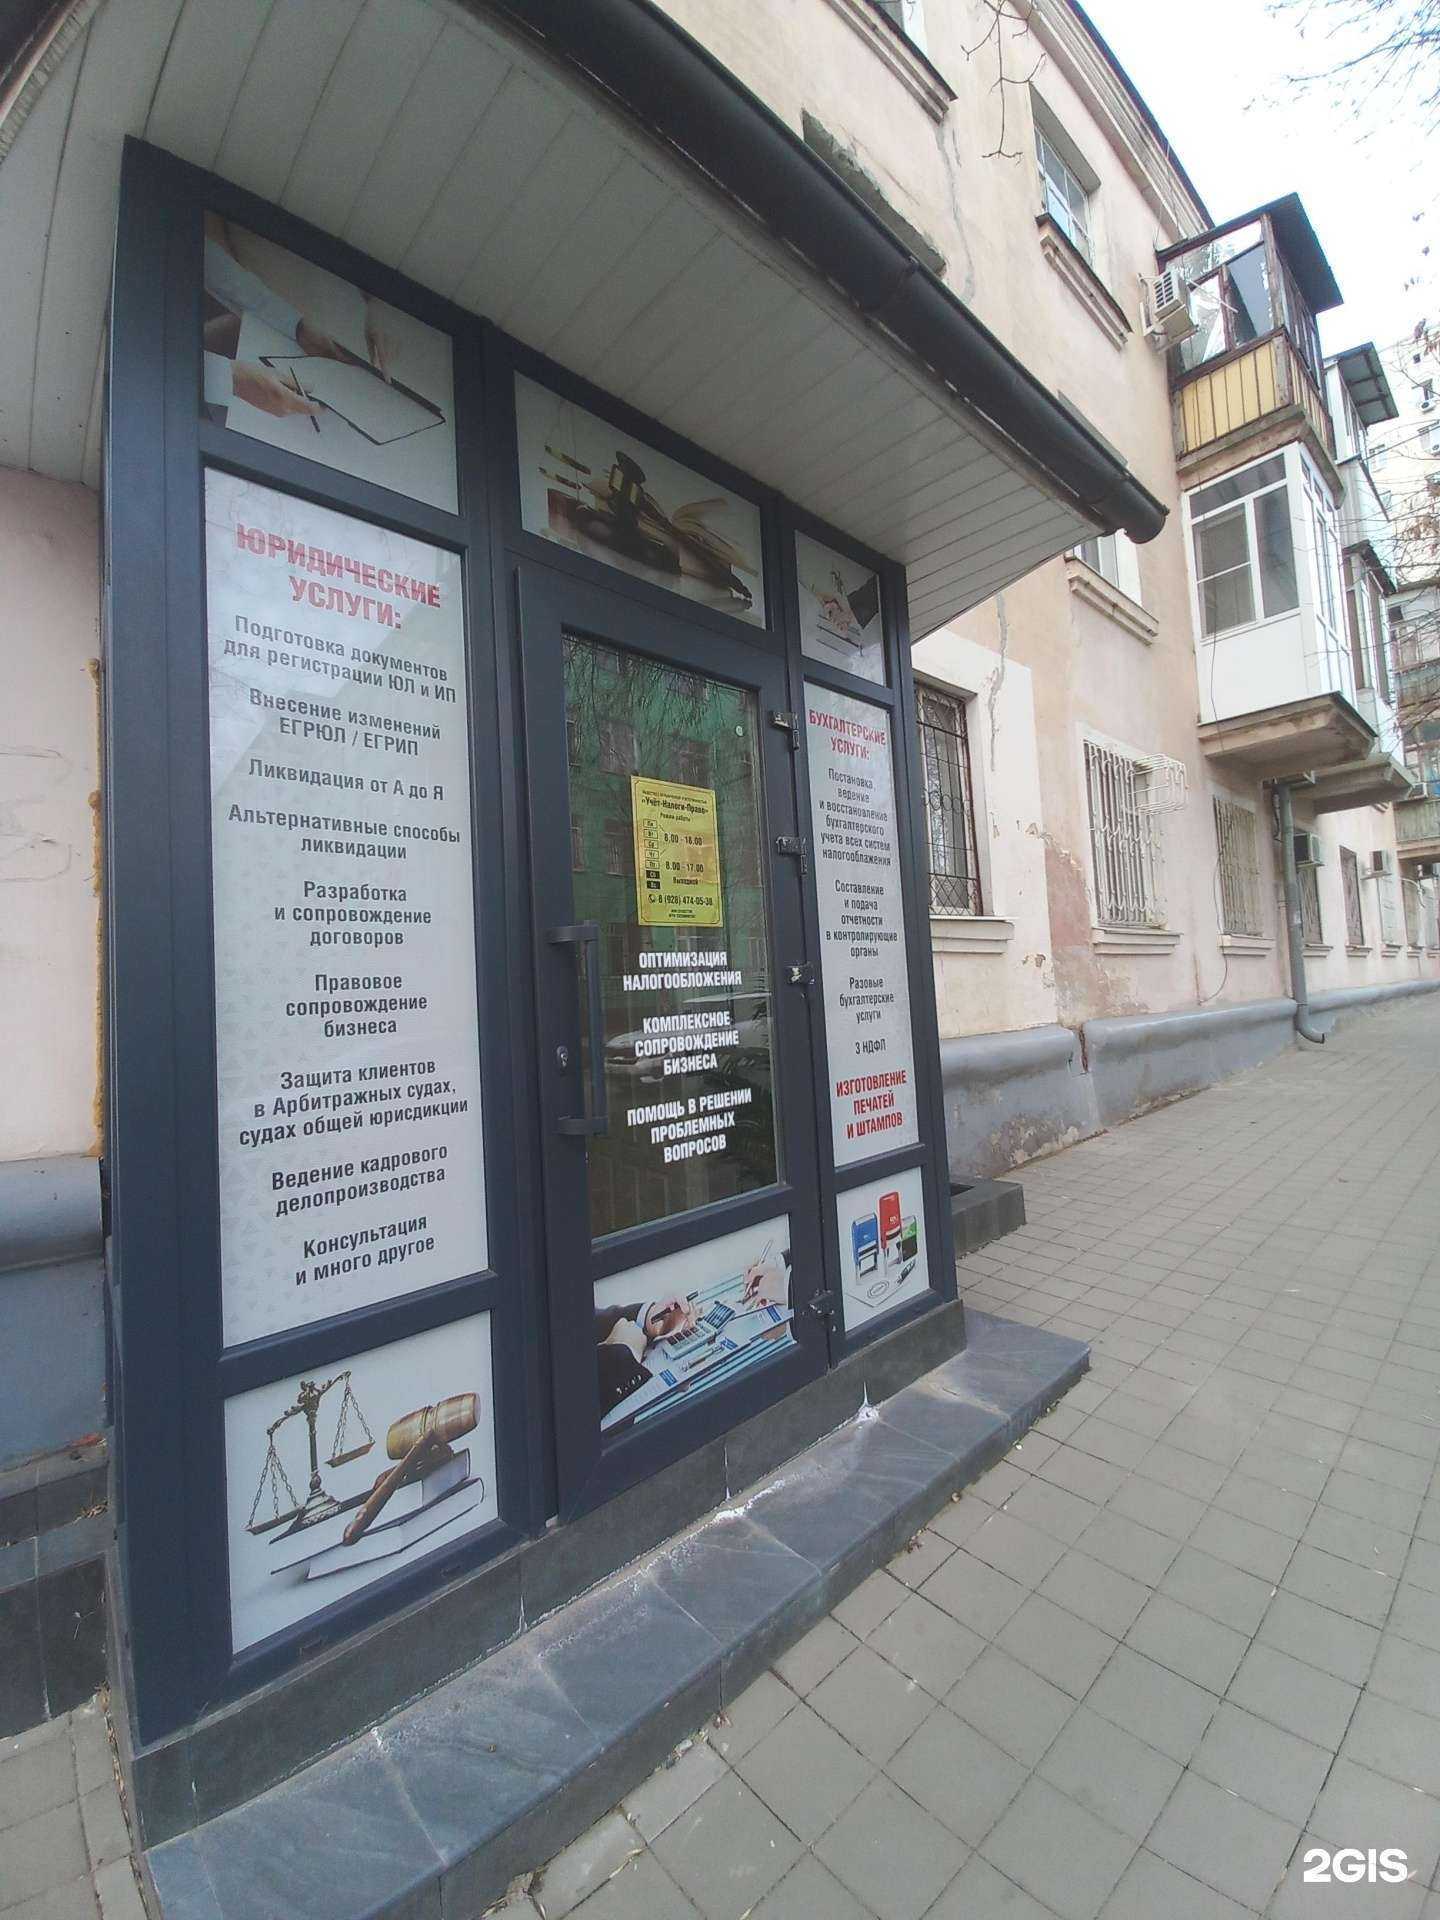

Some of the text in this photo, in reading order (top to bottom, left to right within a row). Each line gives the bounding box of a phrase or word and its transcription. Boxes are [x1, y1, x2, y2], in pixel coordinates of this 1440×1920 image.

[236, 524, 441, 608] ЮРИДИЧЕСКИЕ
[289, 576, 402, 629] УСЛУГИ:
[235, 615, 448, 682] Подготовка документов
[224, 639, 457, 703] для регистрации ЮЛ и ИП
[250, 688, 441, 740] Внесение изменений
[279, 717, 346, 744] ЕГРЮЛ
[364, 732, 418, 756] ЕГРИП
[809, 709, 886, 746] БУХГАЛТЕРСКИЕ
[831, 737, 870, 760] УСЛУГИ:
[248, 759, 444, 801] Ликвидация от А до Я
[819, 800, 824, 810] и
[838, 788, 869, 803] ведение
[228, 803, 461, 843] Альтернативные способы
[826, 814, 885, 836] бухгалтерского
[300, 837, 407, 859] ликвидации
[820, 832, 890, 851] учета всех систем
[303, 880, 407, 902] Разработка
[835, 879, 884, 896] Составление
[274, 906, 432, 925] и сопровождение
[844, 900, 878, 911] и подача
[841, 914, 883, 926] отчетности
[310, 931, 404, 948] договоров
[826, 931, 898, 945] в контролирующие
[639, 951, 728, 969] ОПТИМИЗАЦИЯ
[850, 946, 879, 959] органы
[315, 974, 403, 994] Правовое
[623, 970, 742, 991] НАЛОГООБЛОЖЕНИЯ
[850, 977, 883, 989] Разовые
[286, 996, 428, 1018] сопровождение
[840, 993, 894, 1008] бухгалтерские
[324, 1019, 397, 1038] бизнеса
[643, 1011, 731, 1034] КОМПЛЕКСНОЕ
[856, 1010, 882, 1024] услуги
[635, 1030, 739, 1057] СОПРОВОЖДЕНИЕ
[863, 1038, 886, 1054] НДФЛ
[280, 1060, 436, 1090] Защита клиентов
[663, 1053, 718, 1075] БИЗНЕСА
[836, 1069, 907, 1098] ИЗГОТОВЛЕНИЕ
[254, 1080, 456, 1118] в Арбитражных судах,
[627, 1087, 752, 1126] ПОМОЩЬ В РЕШЕНИИ
[853, 1089, 895, 1115] ПЕЧАТЕЙ
[239, 1100, 469, 1148] судах общей юрисдикции
[651, 1111, 736, 1144] ПРОБЛЕМНЫХ
[846, 1111, 903, 1140] И ШТАМПОВ
[664, 1134, 727, 1163] ВОПРОСОВ
[272, 1146, 448, 1191] Ведение кадрового
[275, 1168, 446, 1218] делопроизводства
[303, 1216, 428, 1259] Консультация
[296, 1236, 435, 1287] и много другое
